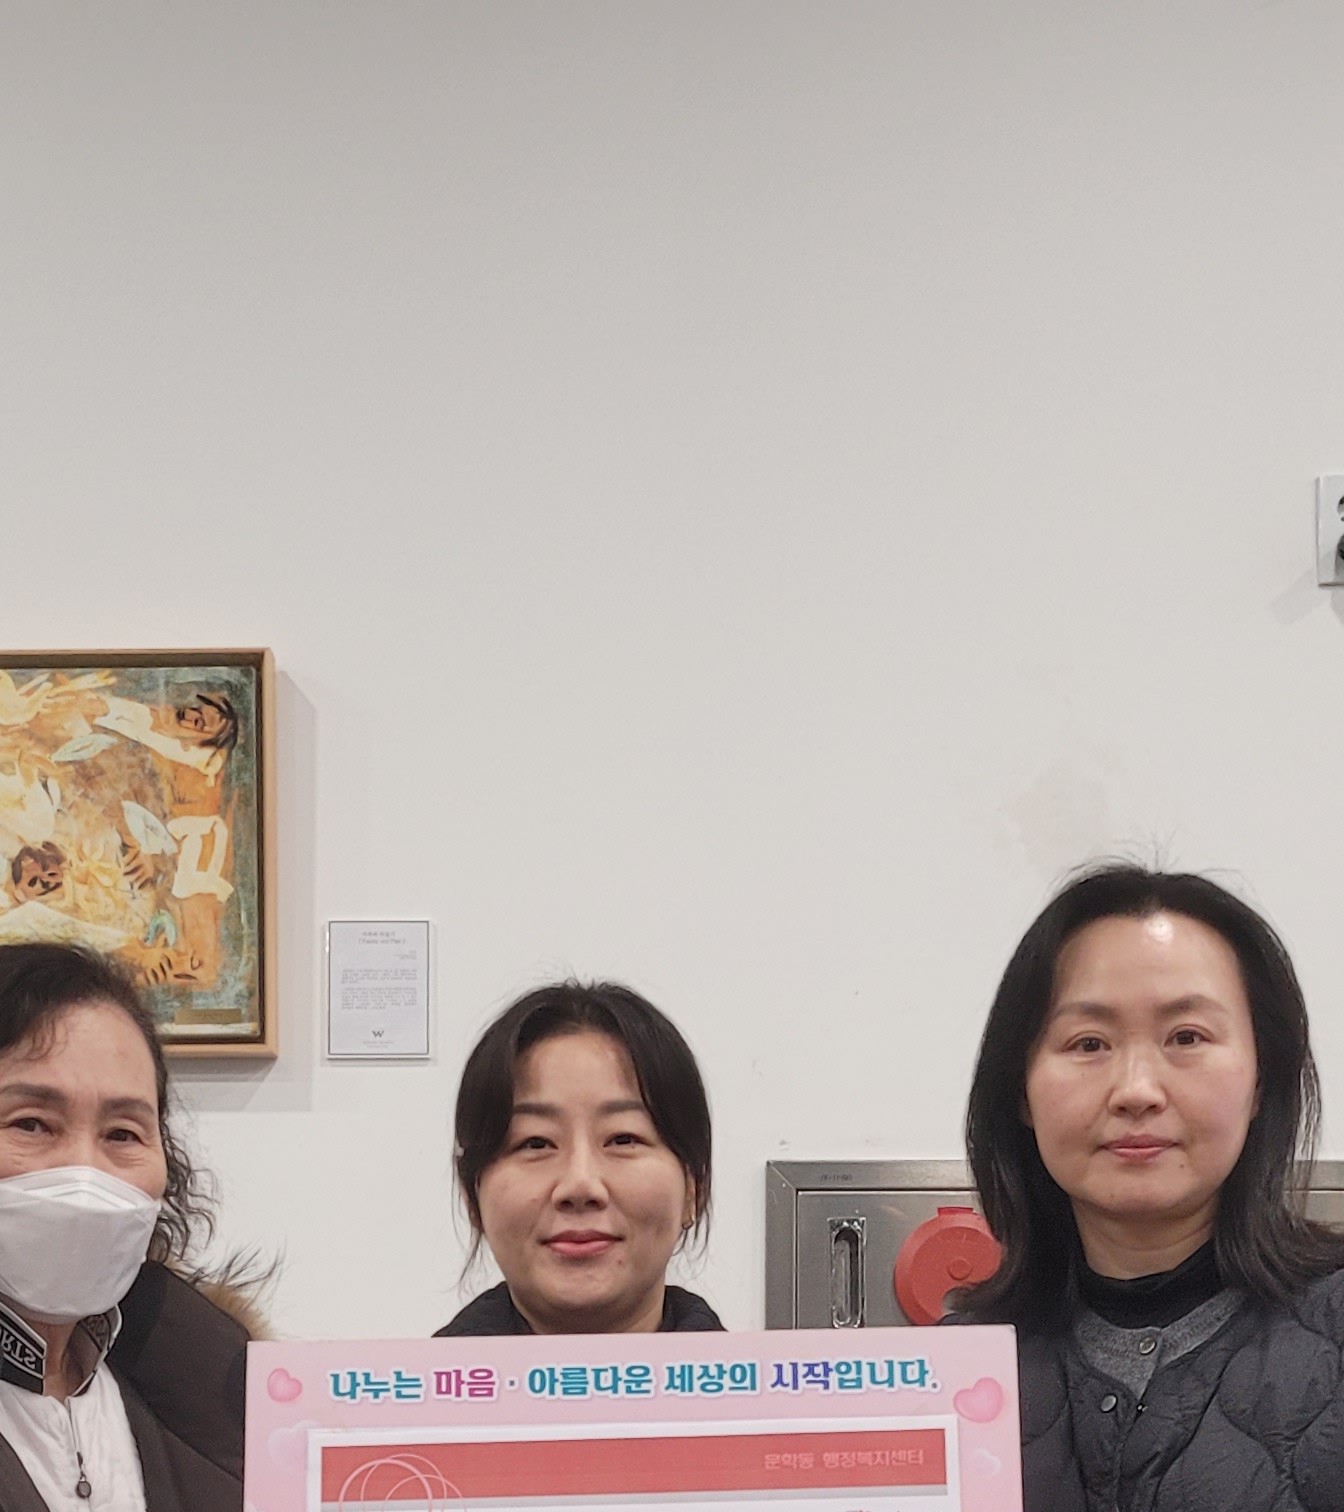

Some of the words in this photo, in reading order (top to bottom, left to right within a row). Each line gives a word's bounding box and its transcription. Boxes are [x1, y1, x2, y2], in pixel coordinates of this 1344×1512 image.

[329, 1370, 423, 1400] 나누는
[433, 1368, 496, 1398] 마음
[527, 1364, 653, 1396] 아름다운
[663, 1362, 757, 1394] 세상의
[770, 1358, 938, 1391] 시작입니다.
[764, 1452, 815, 1470] 문학동
[822, 1449, 924, 1469] 행정복지센터
